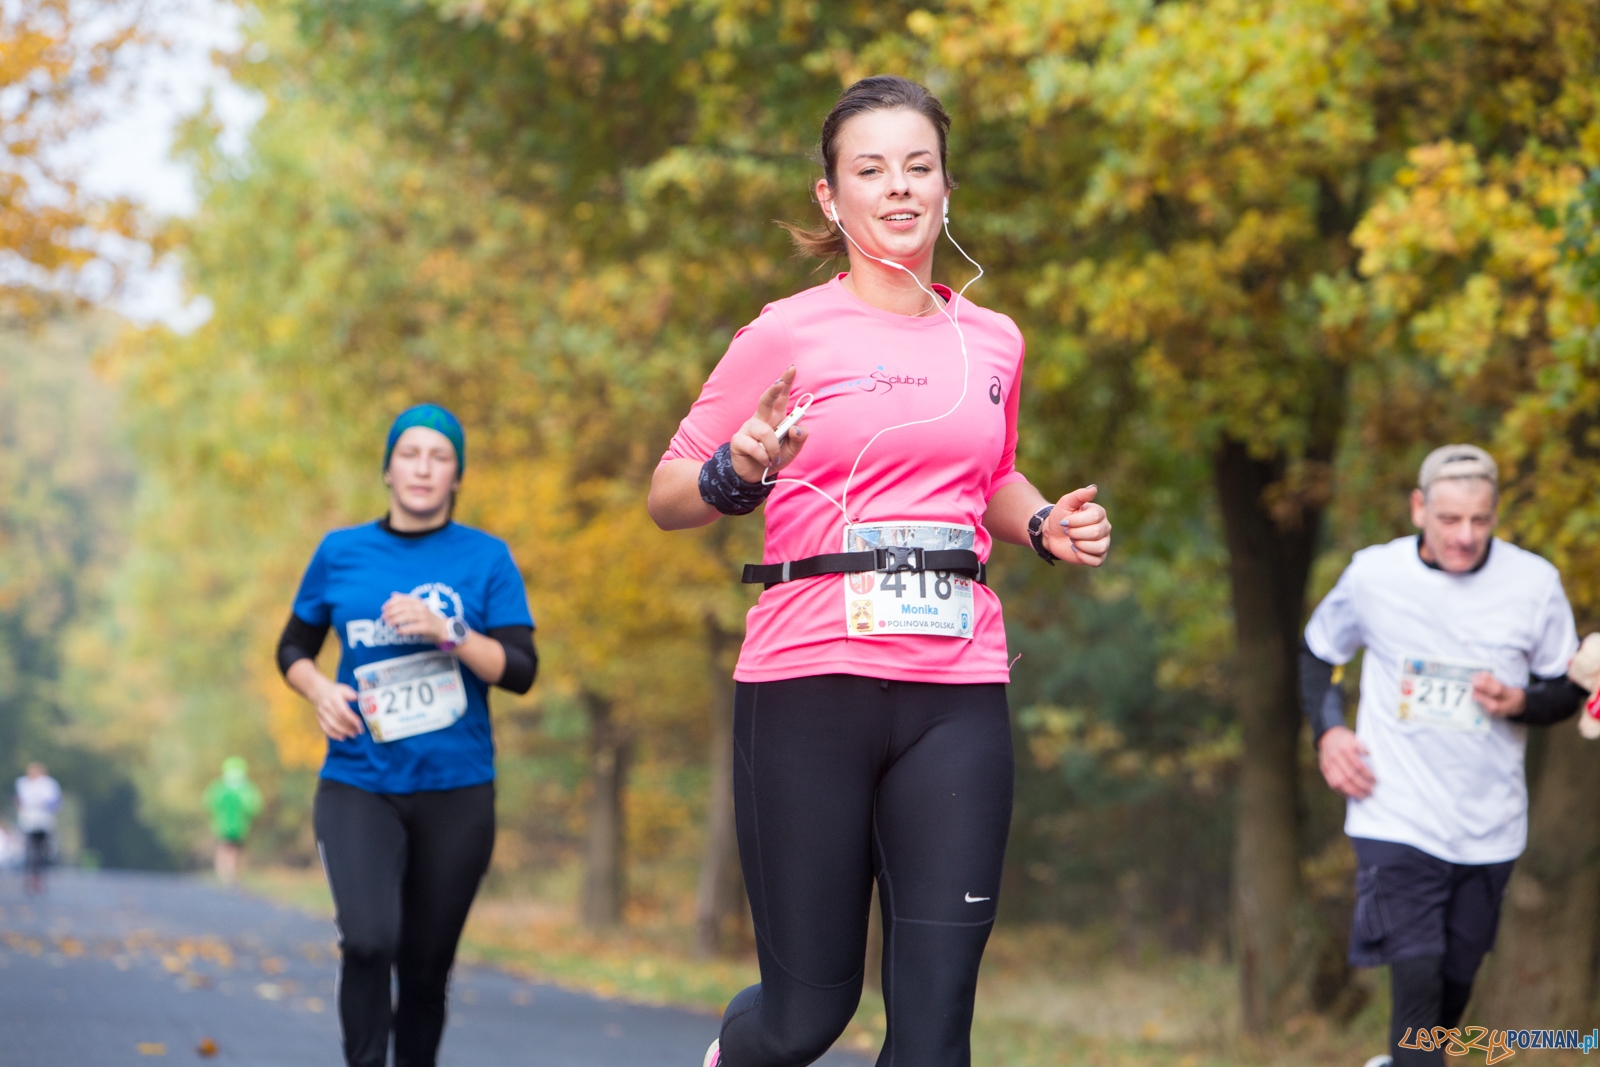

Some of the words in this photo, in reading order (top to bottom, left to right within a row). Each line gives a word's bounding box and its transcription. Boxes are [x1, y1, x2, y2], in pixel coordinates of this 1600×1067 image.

[880, 570, 952, 600] 418
[901, 604, 939, 615] Monika
[887, 620, 929, 628] POLINOVA
[931, 621, 955, 630] POLSKA
[381, 680, 434, 715] 270
[1417, 679, 1468, 707] 217
